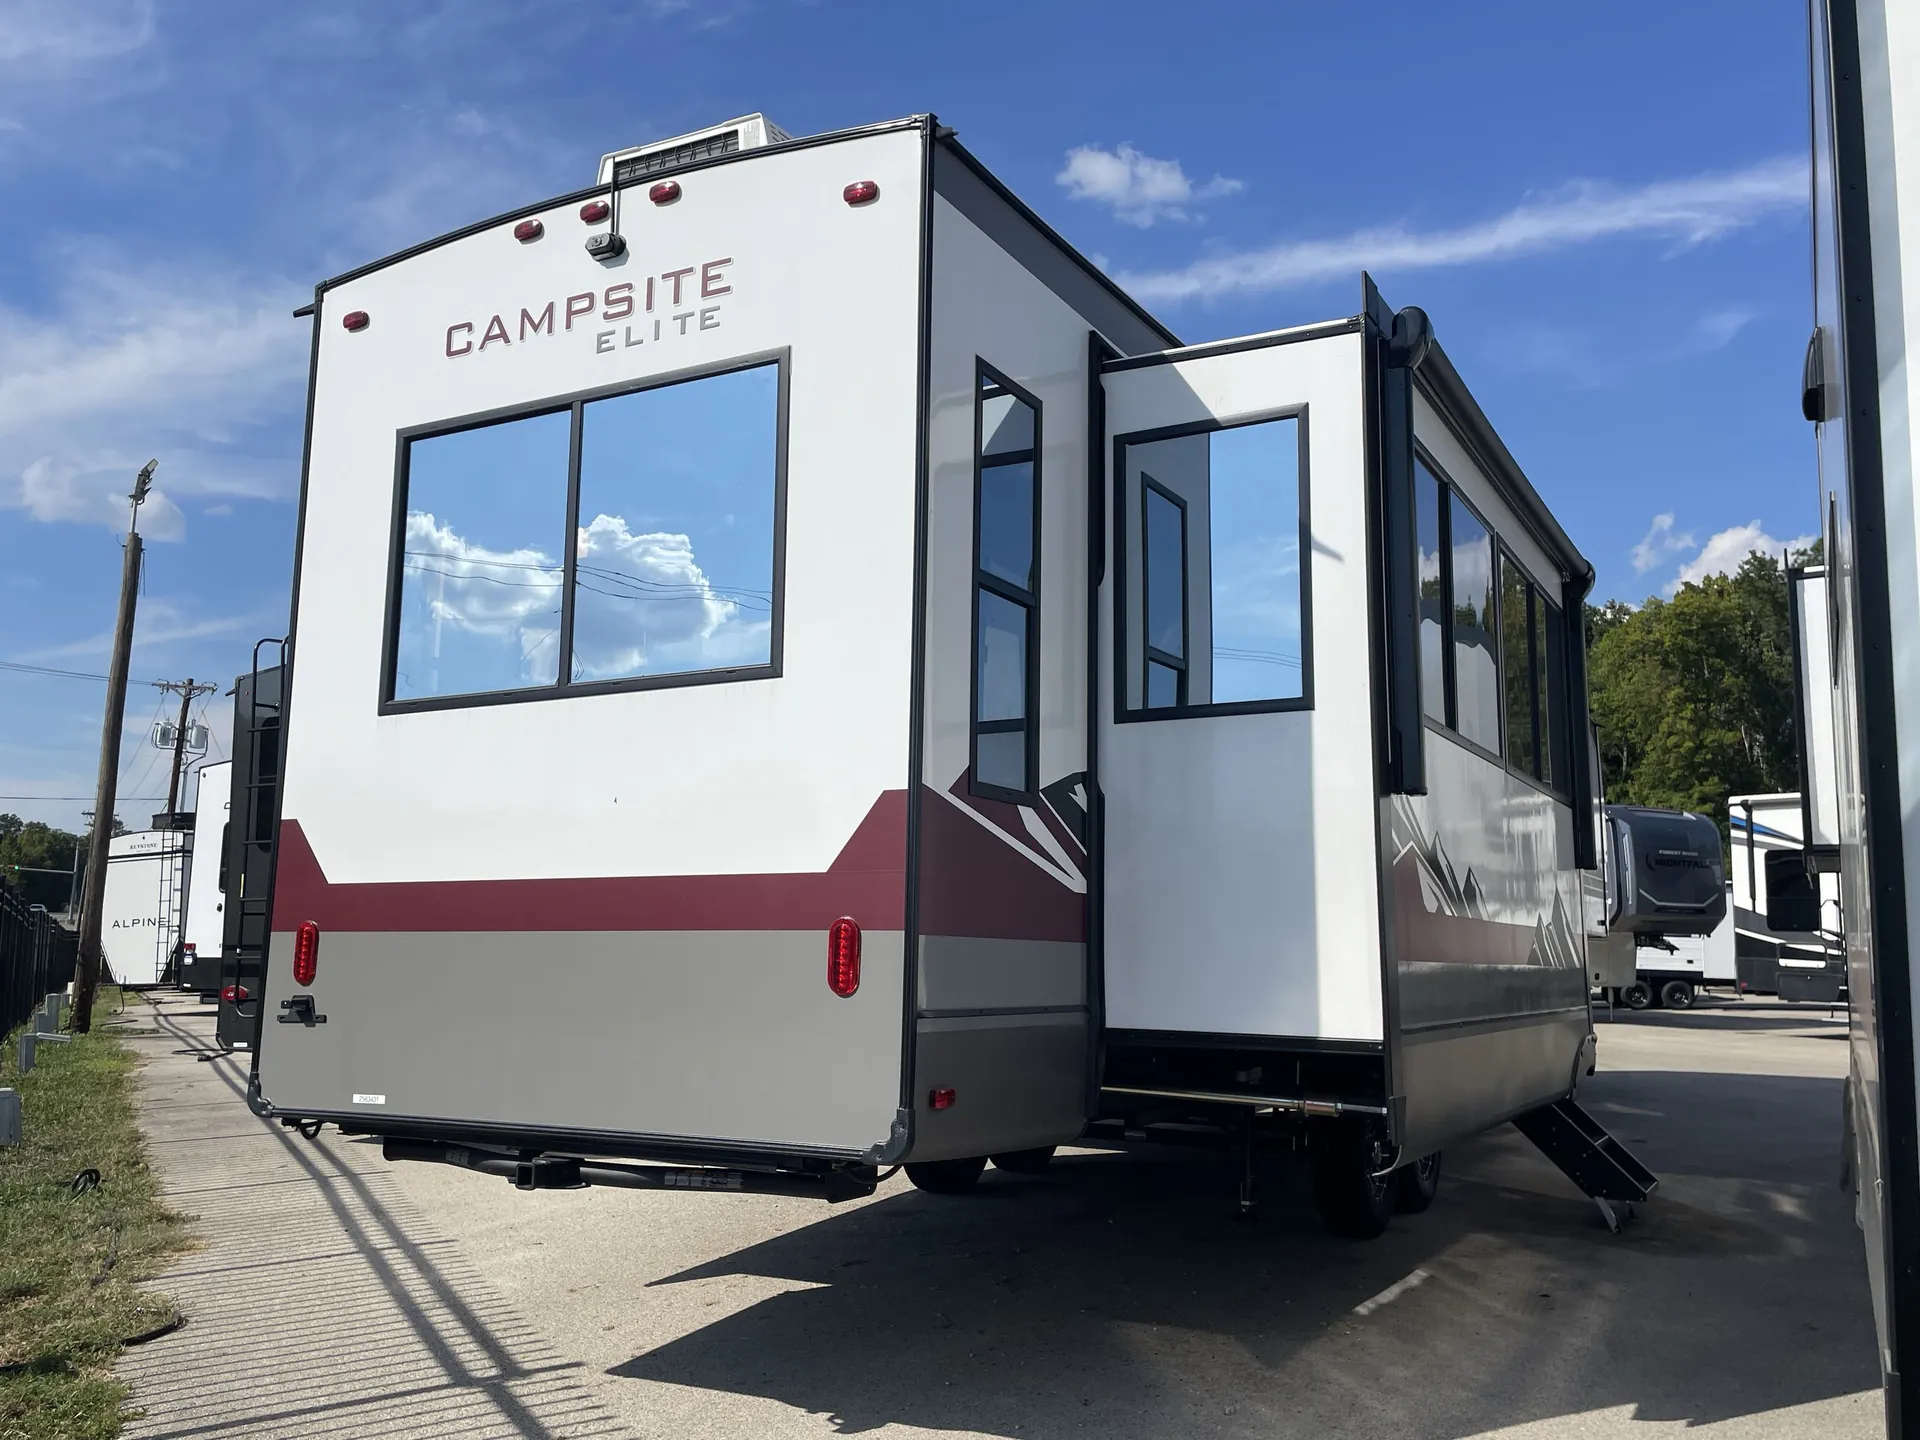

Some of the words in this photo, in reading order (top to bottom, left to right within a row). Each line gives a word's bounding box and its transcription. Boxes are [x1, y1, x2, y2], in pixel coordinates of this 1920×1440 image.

[445, 256, 733, 358] CAMPSITE
[596, 304, 722, 354] ELITE
[112, 917, 167, 929] ALPINE
